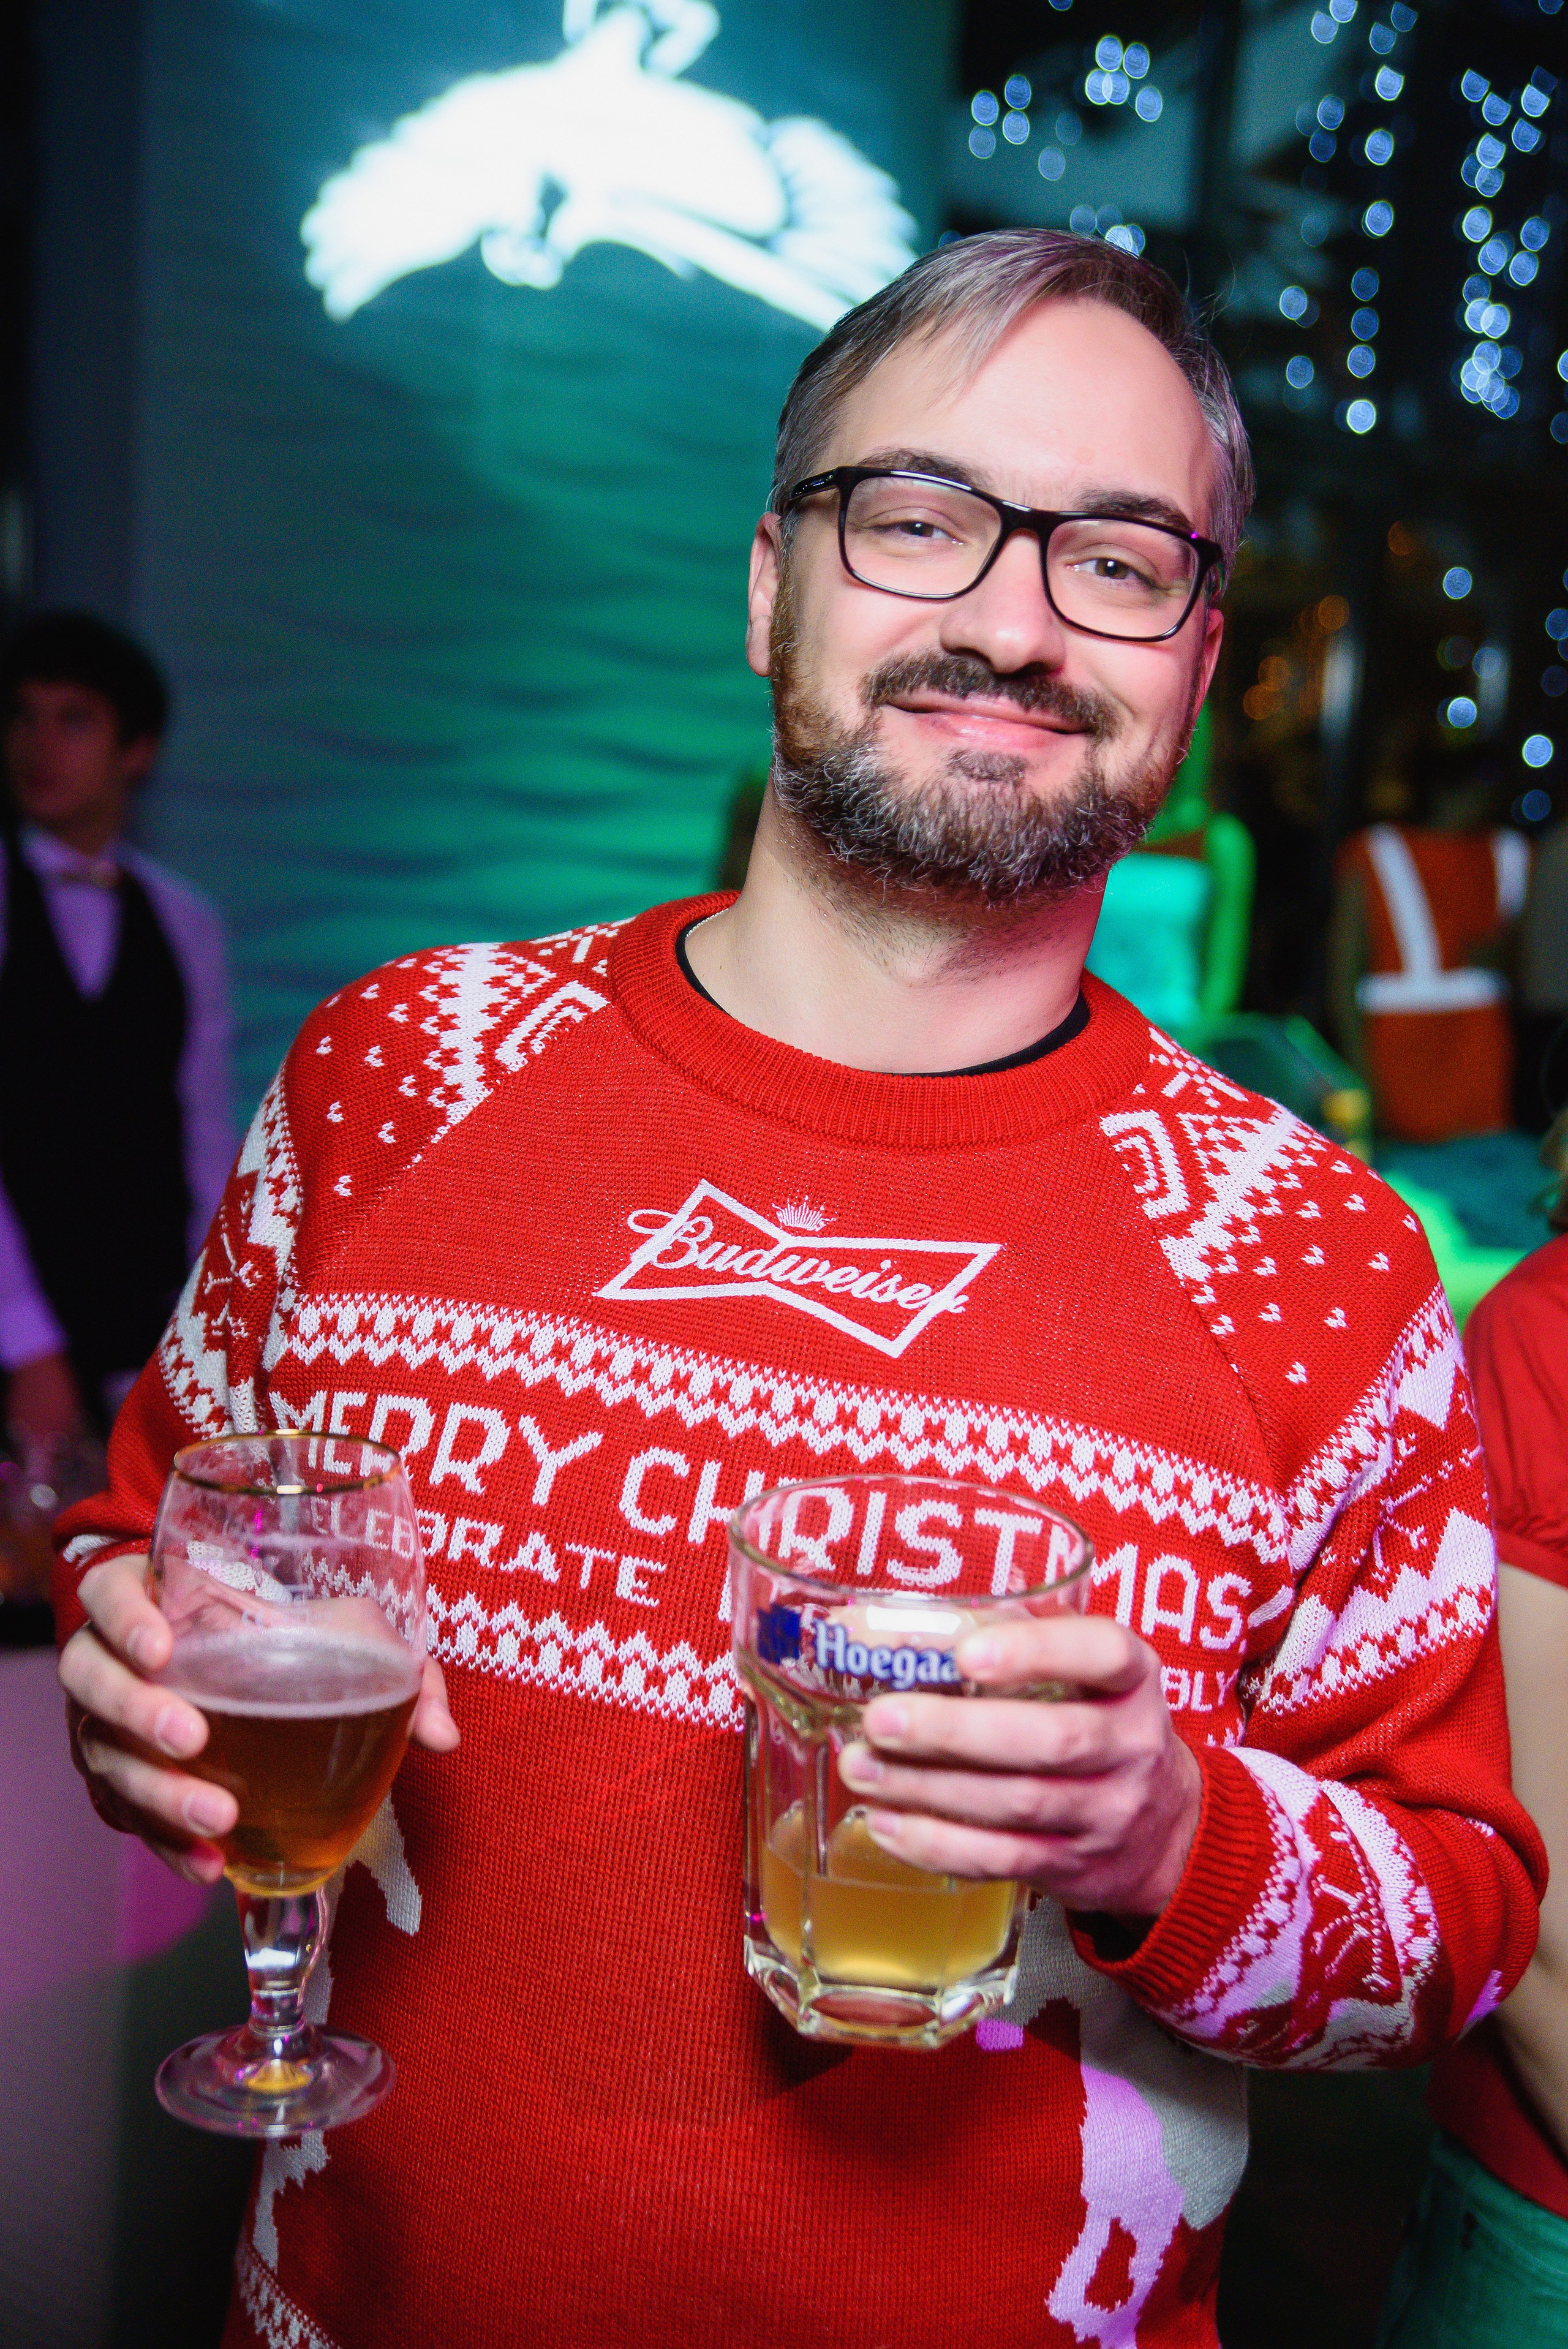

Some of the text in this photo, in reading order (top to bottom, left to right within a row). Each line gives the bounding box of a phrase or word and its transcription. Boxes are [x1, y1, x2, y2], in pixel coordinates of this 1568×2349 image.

[626, 1208, 970, 1314] Budweiser
[268, 1389, 604, 1507] MERRY
[308, 1493, 668, 1608] ELEBRATE
[813, 1616, 962, 1691] Hoegaa
